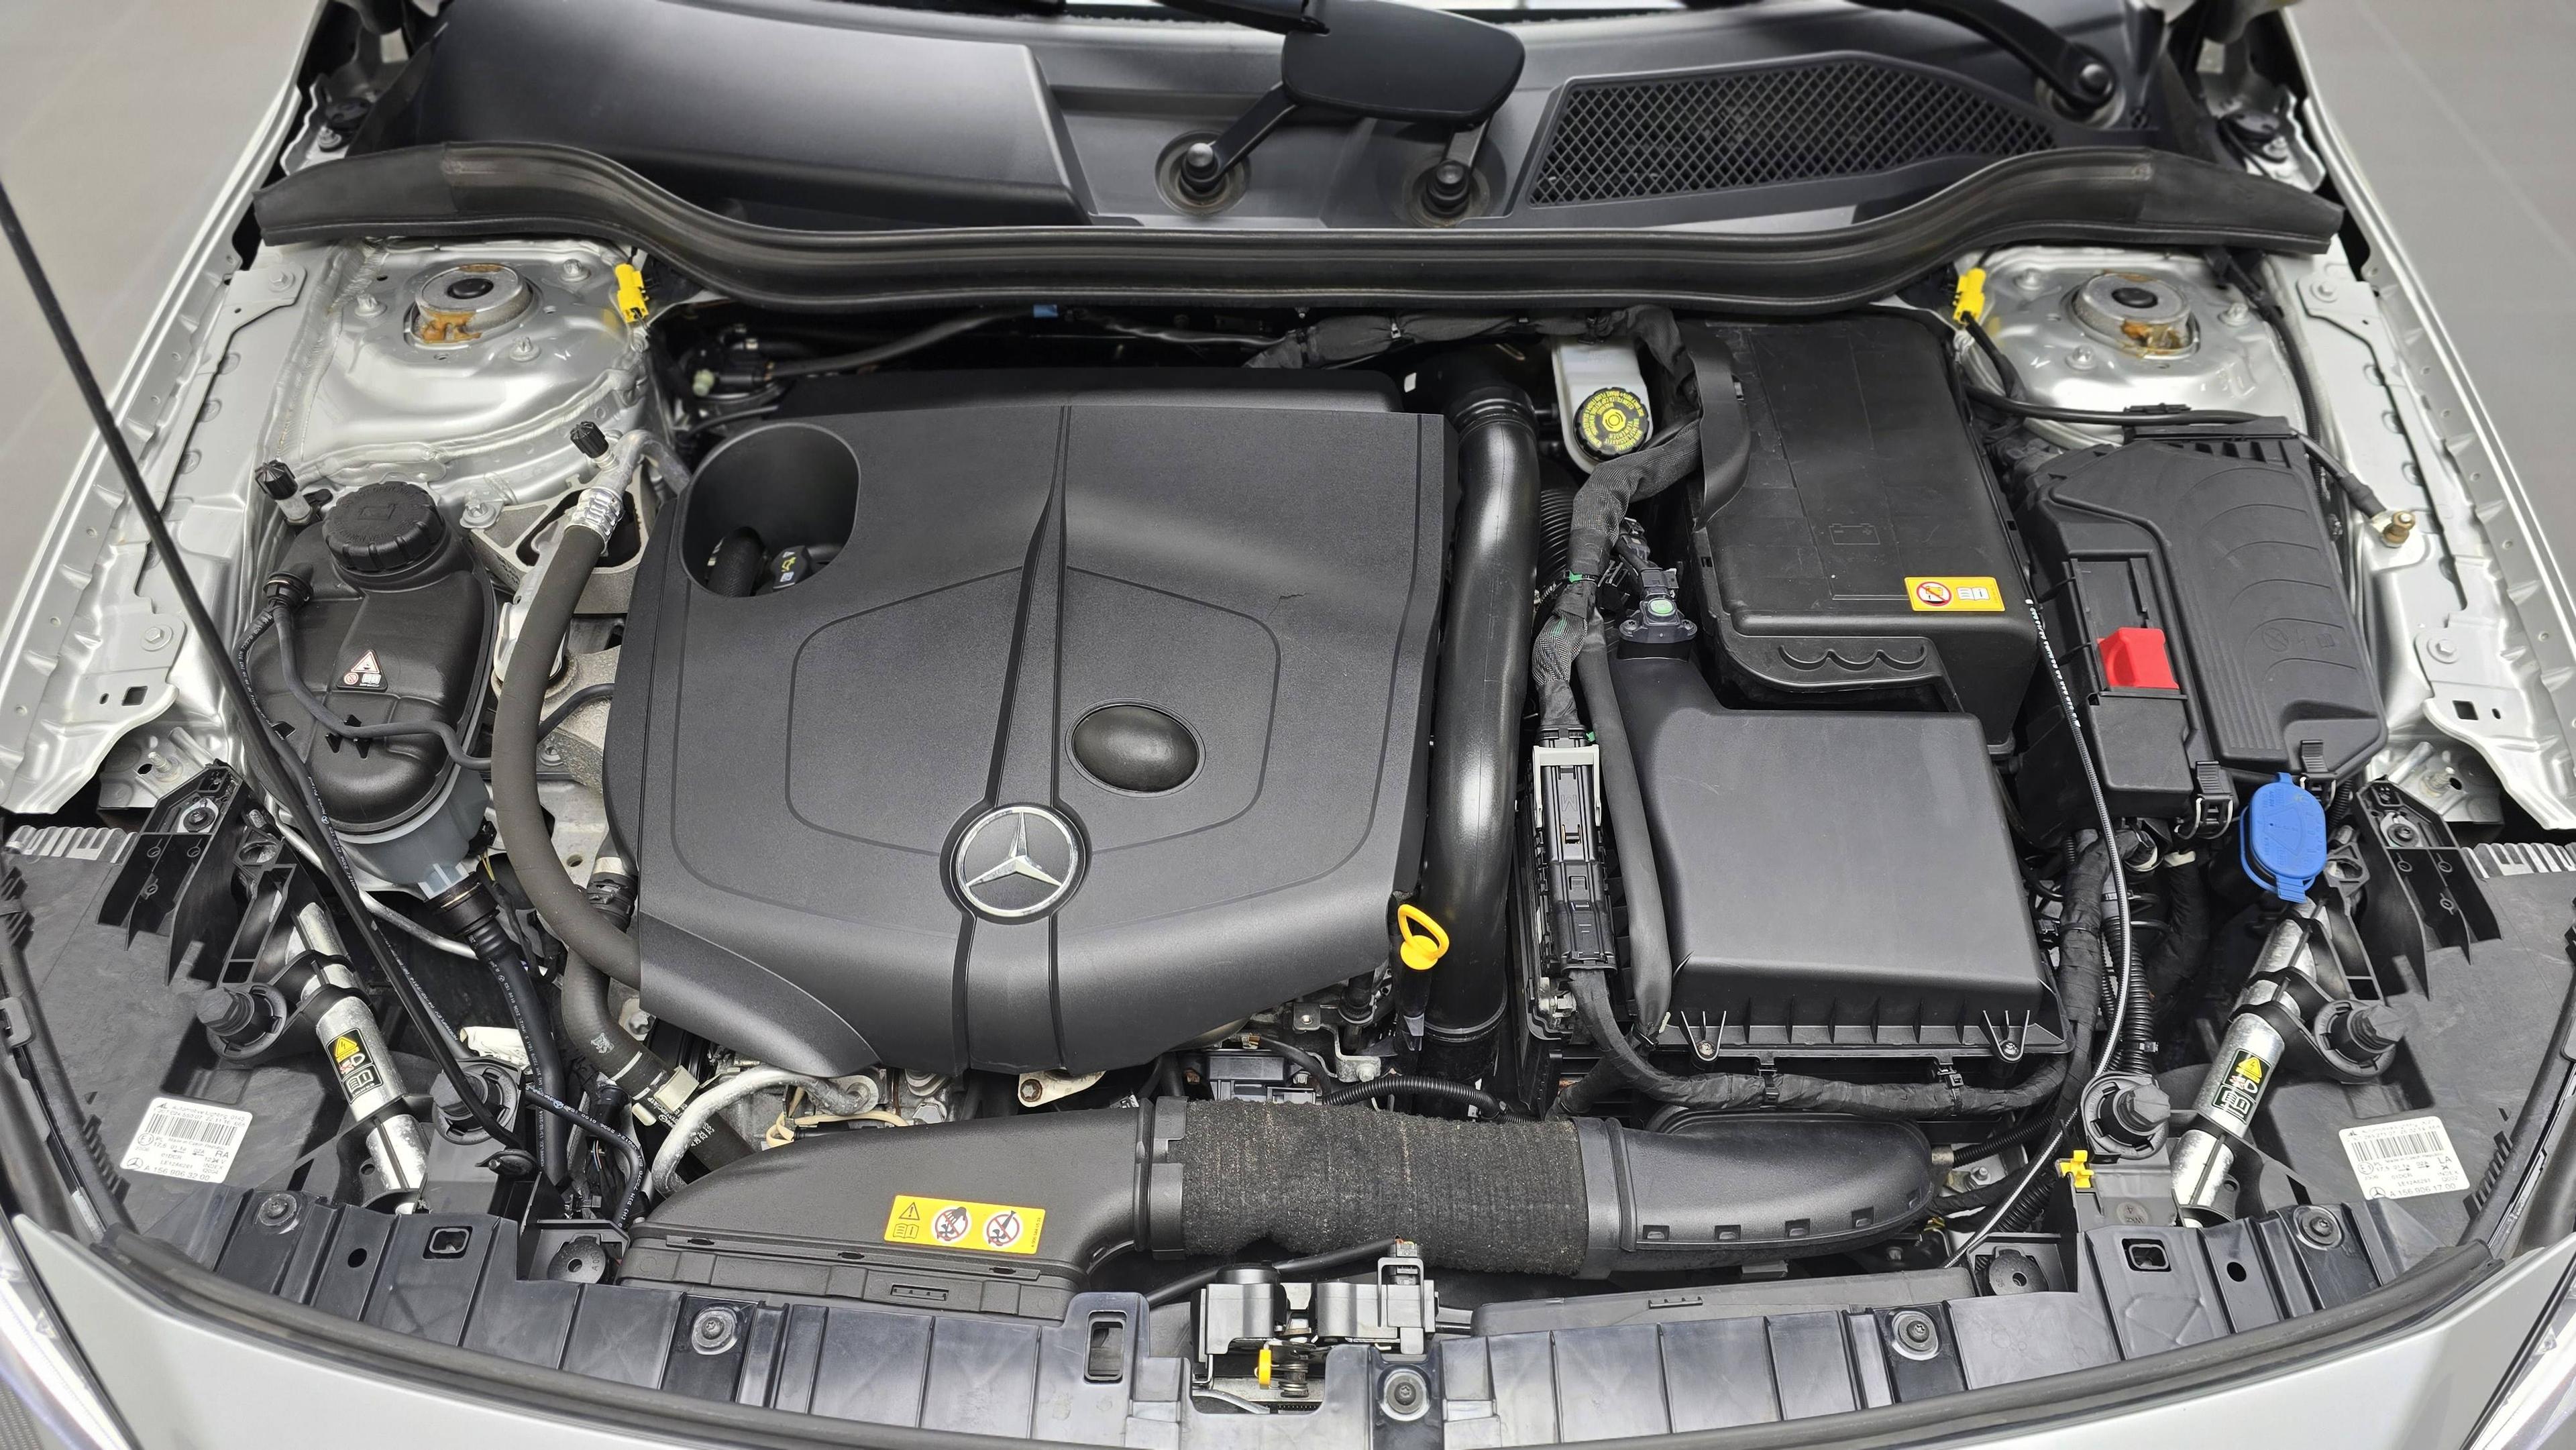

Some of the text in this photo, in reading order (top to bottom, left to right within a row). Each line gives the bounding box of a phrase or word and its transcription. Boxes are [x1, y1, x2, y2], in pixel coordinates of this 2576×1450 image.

[214, 1150, 229, 1158] RA
[2436, 1156, 2452, 1164] LA
[169, 1169, 186, 1177] 906
